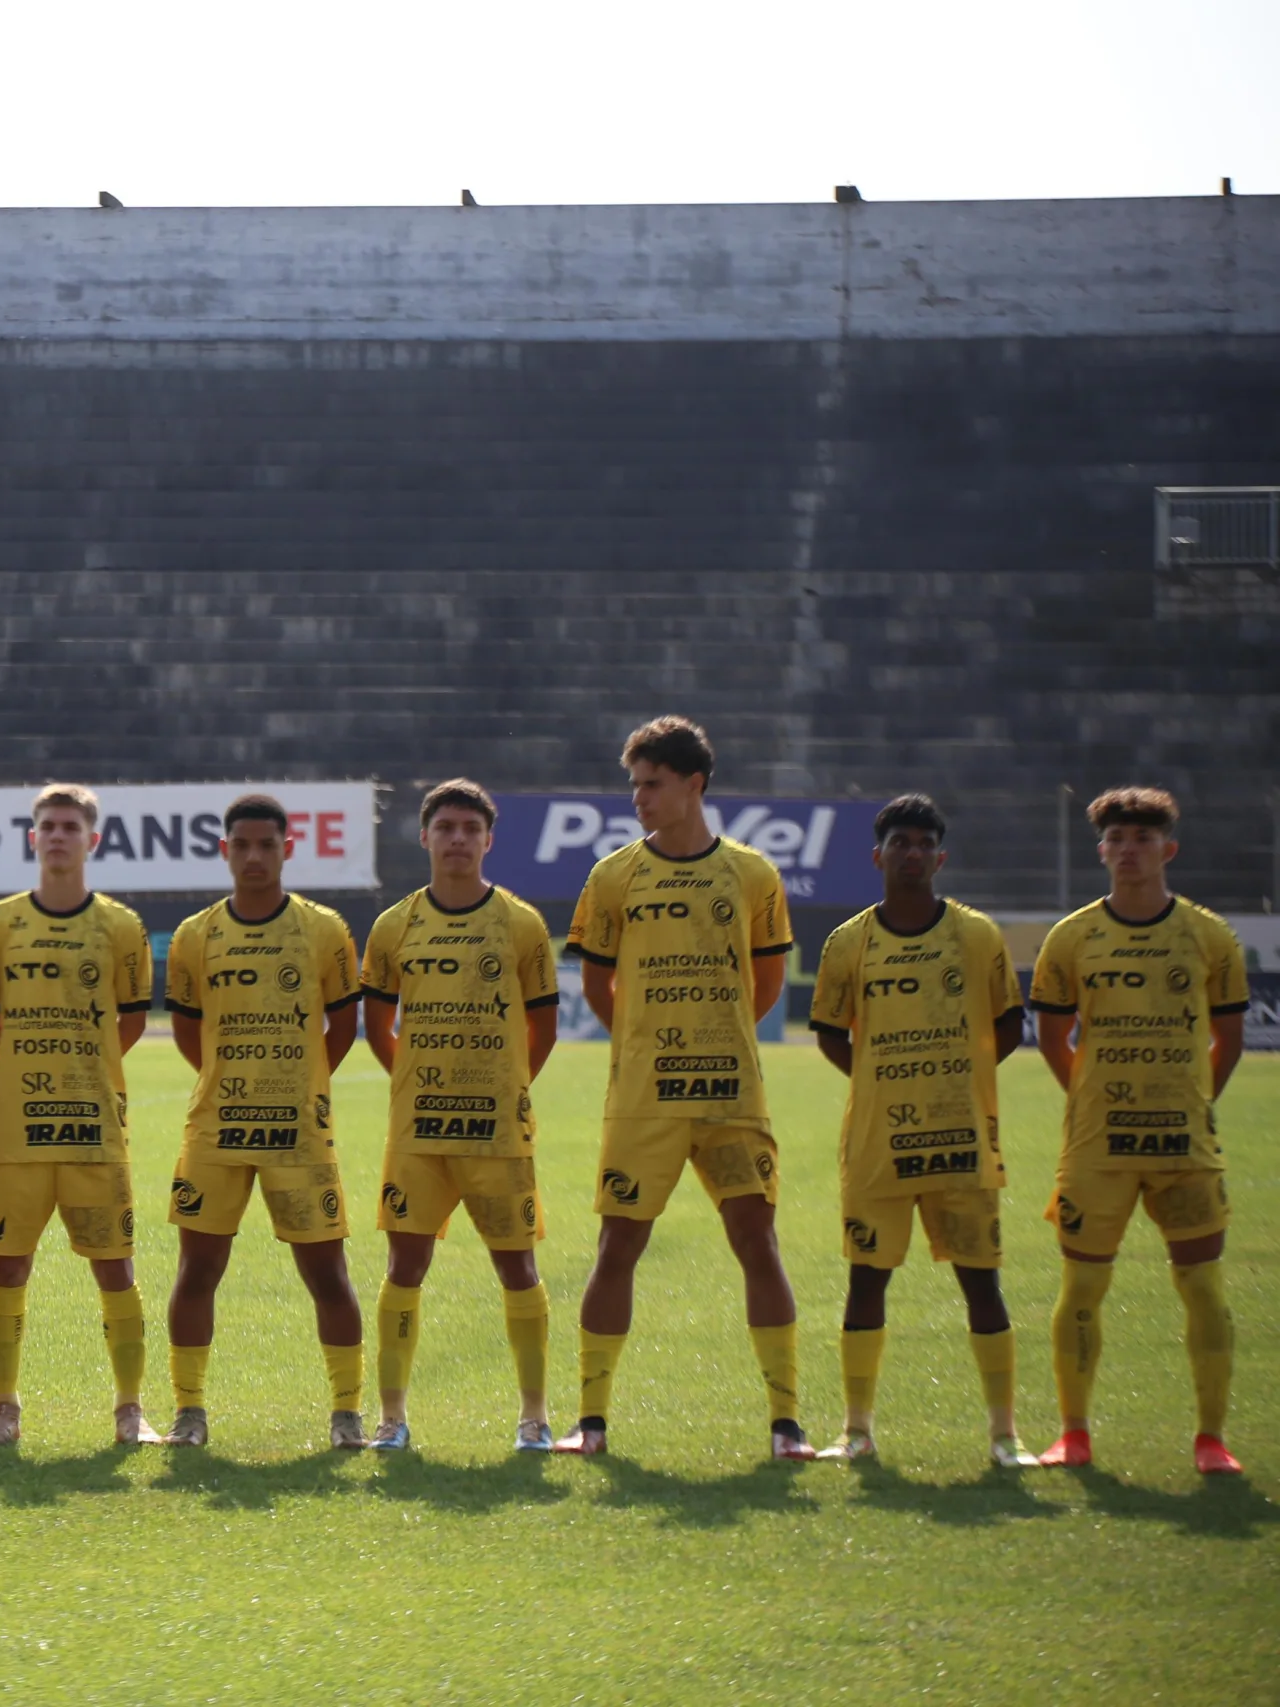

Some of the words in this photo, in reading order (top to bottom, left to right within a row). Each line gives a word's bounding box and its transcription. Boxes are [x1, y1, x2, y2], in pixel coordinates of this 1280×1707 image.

[655, 879, 714, 889] EUCATUR
[626, 902, 690, 923] KTO
[428, 936, 486, 945] EUCATUR
[226, 946, 283, 956] EUCATUR
[5, 962, 60, 982] KTO
[400, 958, 460, 975] KTO
[208, 969, 258, 990] KTO
[1082, 971, 1146, 990] KTO
[645, 986, 704, 1004] FOSFO
[709, 986, 739, 1002] 500
[404, 1002, 495, 1015] MANTOVANI
[218, 1012, 295, 1026] ANTOVANI
[13, 1039, 71, 1056] FOSFO
[410, 1033, 464, 1050] FOSFO
[470, 1034, 504, 1050] 500
[271, 1045, 304, 1060] 500
[1097, 1048, 1157, 1065] FOSFO
[1161, 1048, 1193, 1064] 500
[657, 1057, 736, 1071] COOPAVEL
[876, 1060, 937, 1082] FOSFO
[26, 1103, 98, 1116] COOPAVEL
[416, 1096, 494, 1110] COOPAVEL
[221, 1107, 296, 1120] COOPAVEL
[891, 1131, 974, 1149] COOPAVEL
